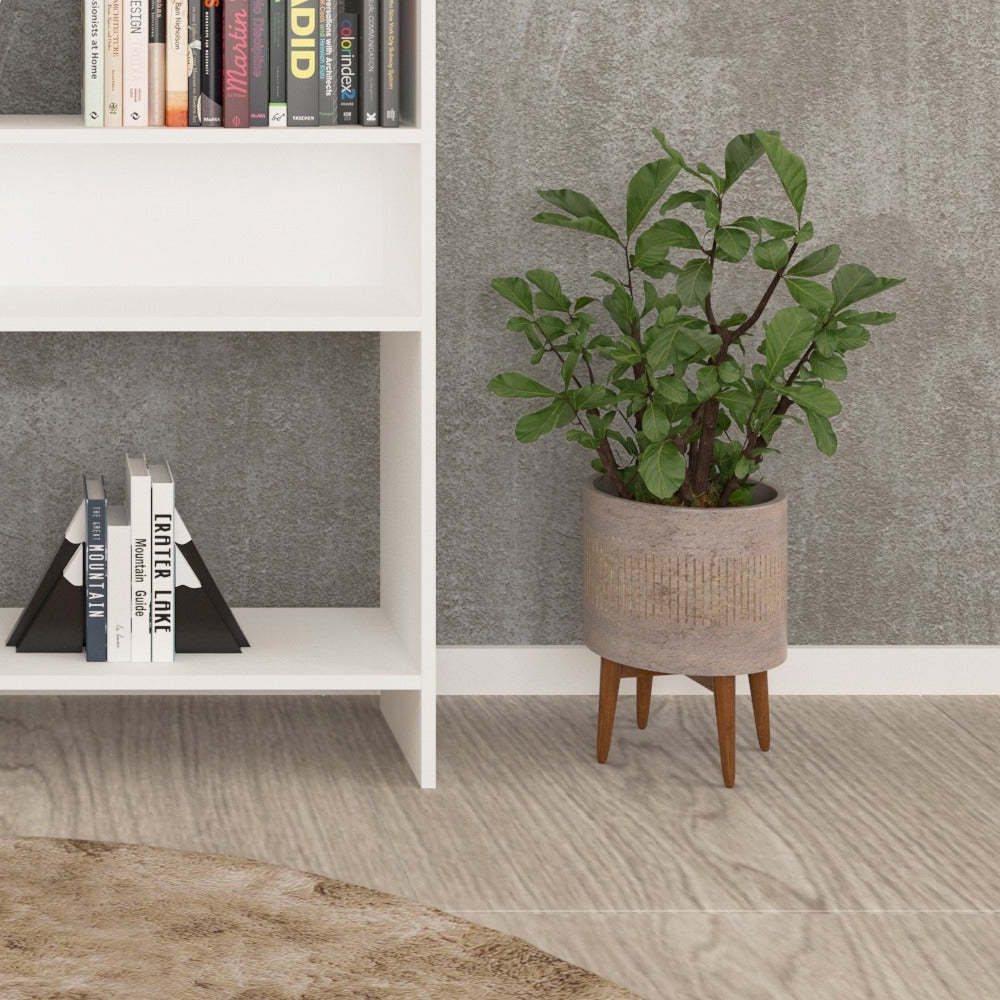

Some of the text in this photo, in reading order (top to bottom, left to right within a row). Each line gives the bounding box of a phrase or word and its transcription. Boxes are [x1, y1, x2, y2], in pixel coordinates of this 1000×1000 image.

[91, 40, 98, 50] at
[91, 53, 99, 80] Home
[226, 9, 248, 93] Martin
[89, 507, 104, 618] THE GREAT MOUNTAIN
[135, 538, 146, 617] Mountain Guide
[154, 514, 172, 633] CRATER LAKE
